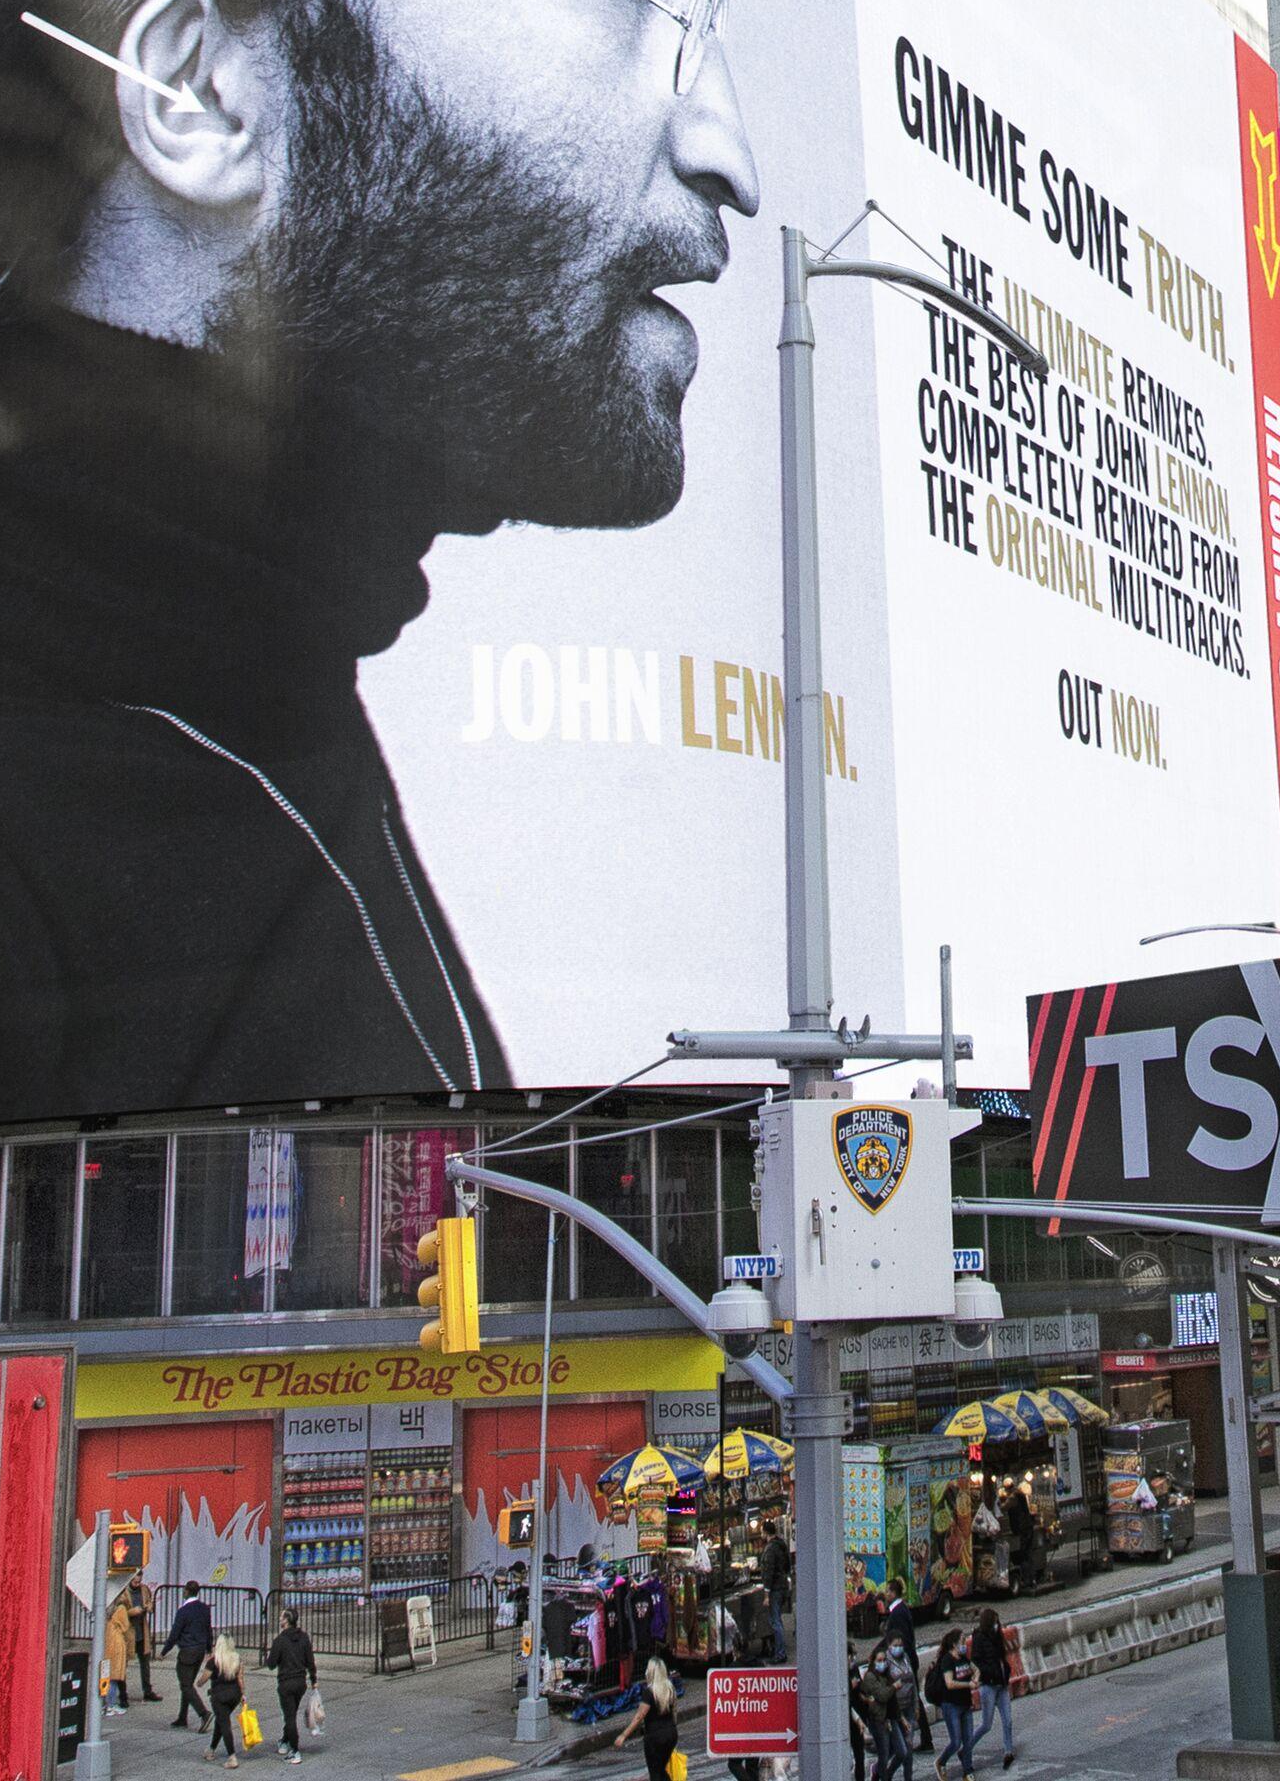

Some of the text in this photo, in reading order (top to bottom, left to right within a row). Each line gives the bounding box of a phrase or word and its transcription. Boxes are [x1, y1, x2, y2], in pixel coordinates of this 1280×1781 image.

[895, 36, 1235, 374] GIMME SOME TRUTH.
[942, 233, 993, 314] THE
[1121, 356, 1212, 470] REMIXES.
[923, 299, 1237, 547] THE BEST OF JOHN LENNON.
[919, 378, 1242, 613] COMPLETELY REMIXED FROM
[920, 460, 1251, 680] THE ORIGINAL MULTITRACKS.
[461, 643, 858, 783] JOHN LENNN.
[1058, 669, 1168, 771] OUT NOW.
[838, 1121, 907, 1141] DEPARTMENT
[852, 1110, 893, 1124] POLICE
[840, 1152, 866, 1195] CITY OF
[880, 1146, 908, 1199] NEW YORK
[735, 1256, 776, 1278] NYPD
[953, 1250, 981, 1270] YPD
[920, 1328, 946, 1357] 袋子
[1034, 1324, 1060, 1341] BAGS
[163, 1365, 233, 1410] The
[239, 1361, 370, 1397] Plastic
[376, 1356, 459, 1396] Bag
[288, 1417, 363, 1437] пакеты
[400, 1405, 425, 1440] 백
[658, 1402, 716, 1418] BORSE
[714, 1676, 797, 1694] NO STANDING
[715, 1697, 769, 1716] Anytime
